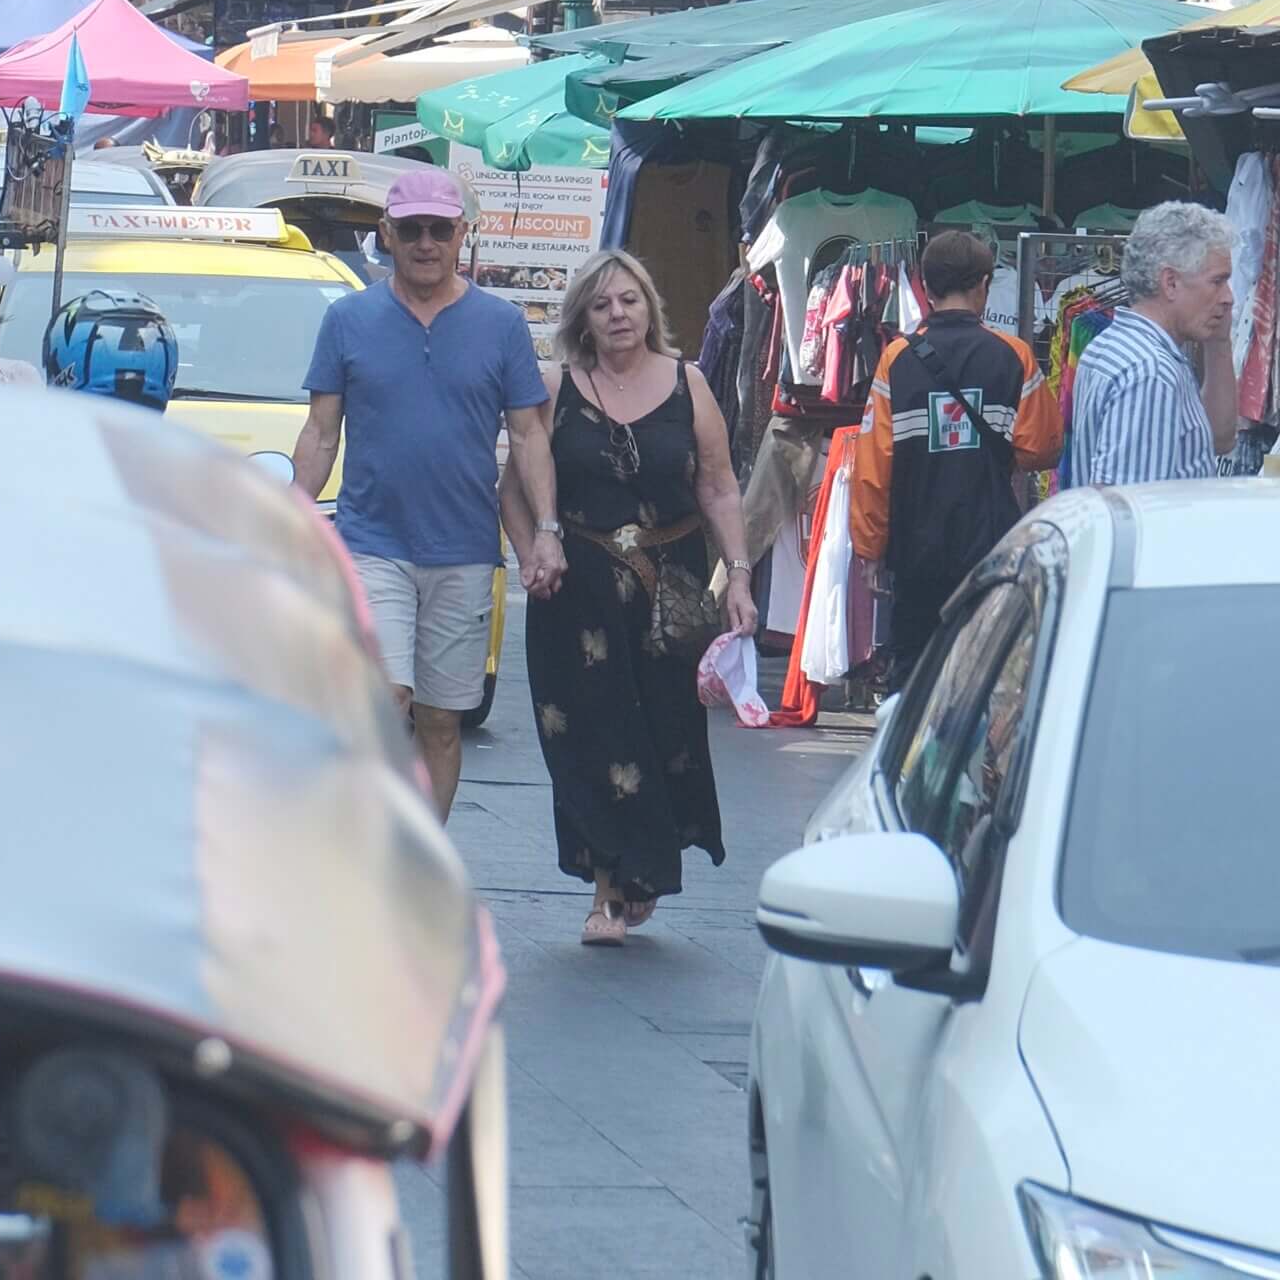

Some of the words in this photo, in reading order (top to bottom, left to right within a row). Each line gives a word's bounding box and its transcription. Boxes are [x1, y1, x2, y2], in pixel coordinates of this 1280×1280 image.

[299, 157, 350, 179] TAXI
[475, 172, 509, 181] UNLOCK
[554, 175, 592, 184] SAVINGS!
[533, 193, 555, 201] ROOM
[522, 202, 543, 210] ENJOY
[88, 214, 253, 231] TAXI-METER
[510, 216, 585, 232] DISCOUNT
[492, 242, 528, 250] PARTNER
[532, 243, 591, 253] RESTAURANTS
